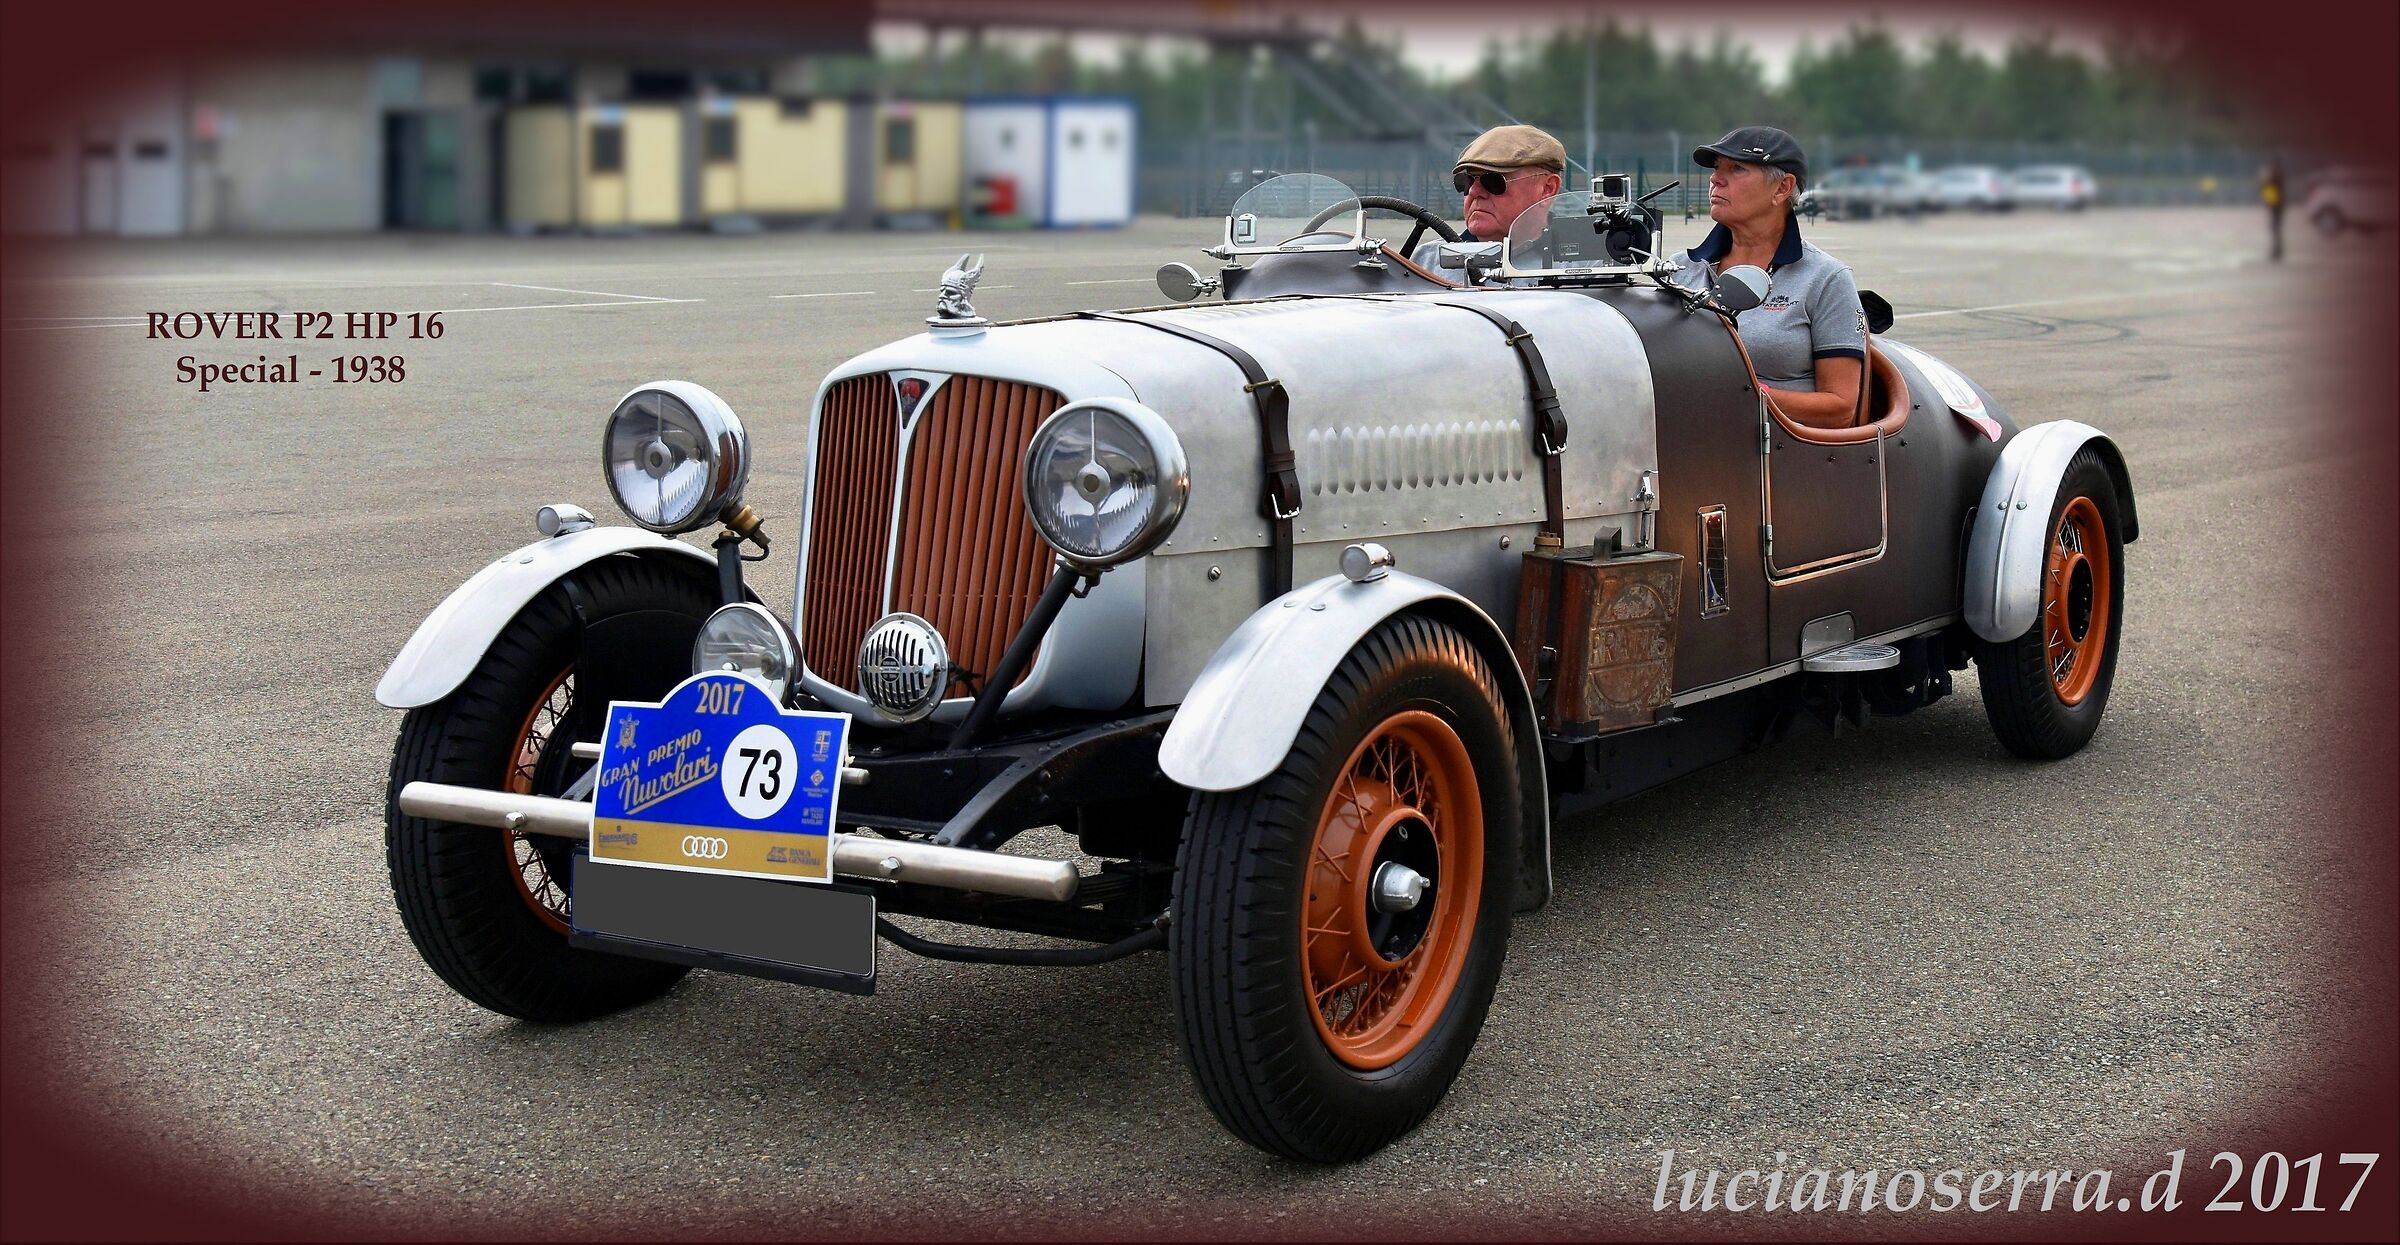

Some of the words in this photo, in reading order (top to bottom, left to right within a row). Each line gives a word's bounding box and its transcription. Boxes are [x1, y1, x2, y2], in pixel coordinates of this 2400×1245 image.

[695, 681, 745, 715] 2017
[601, 756, 640, 788] GRAN
[647, 728, 703, 768] PREMIO
[618, 746, 719, 815] Nuvolari
[738, 747, 783, 801] 73
